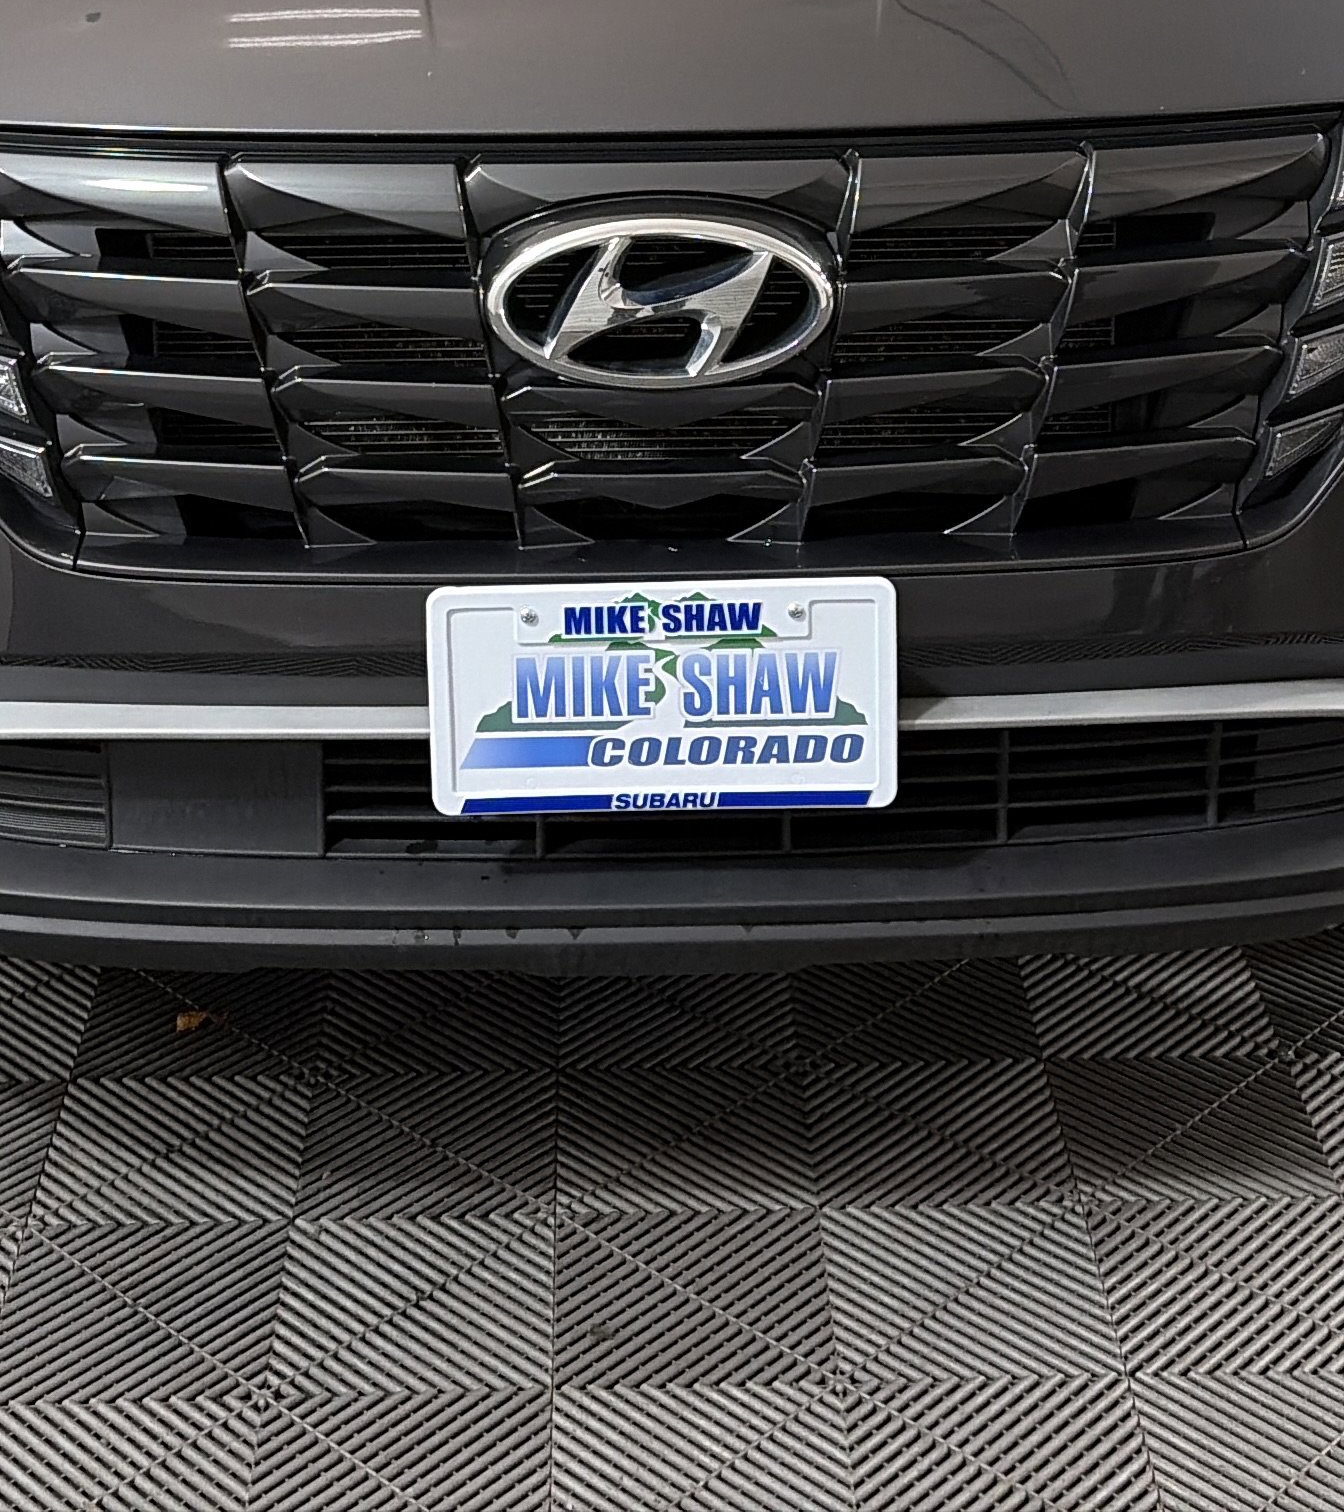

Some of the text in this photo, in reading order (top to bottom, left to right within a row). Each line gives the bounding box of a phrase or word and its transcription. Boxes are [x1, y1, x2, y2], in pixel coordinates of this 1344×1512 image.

[563, 602, 762, 635] MIKE SHAW
[515, 651, 836, 718] MIKE SHAW
[590, 733, 865, 768] COLORADO
[613, 791, 718, 810] SUBARU
